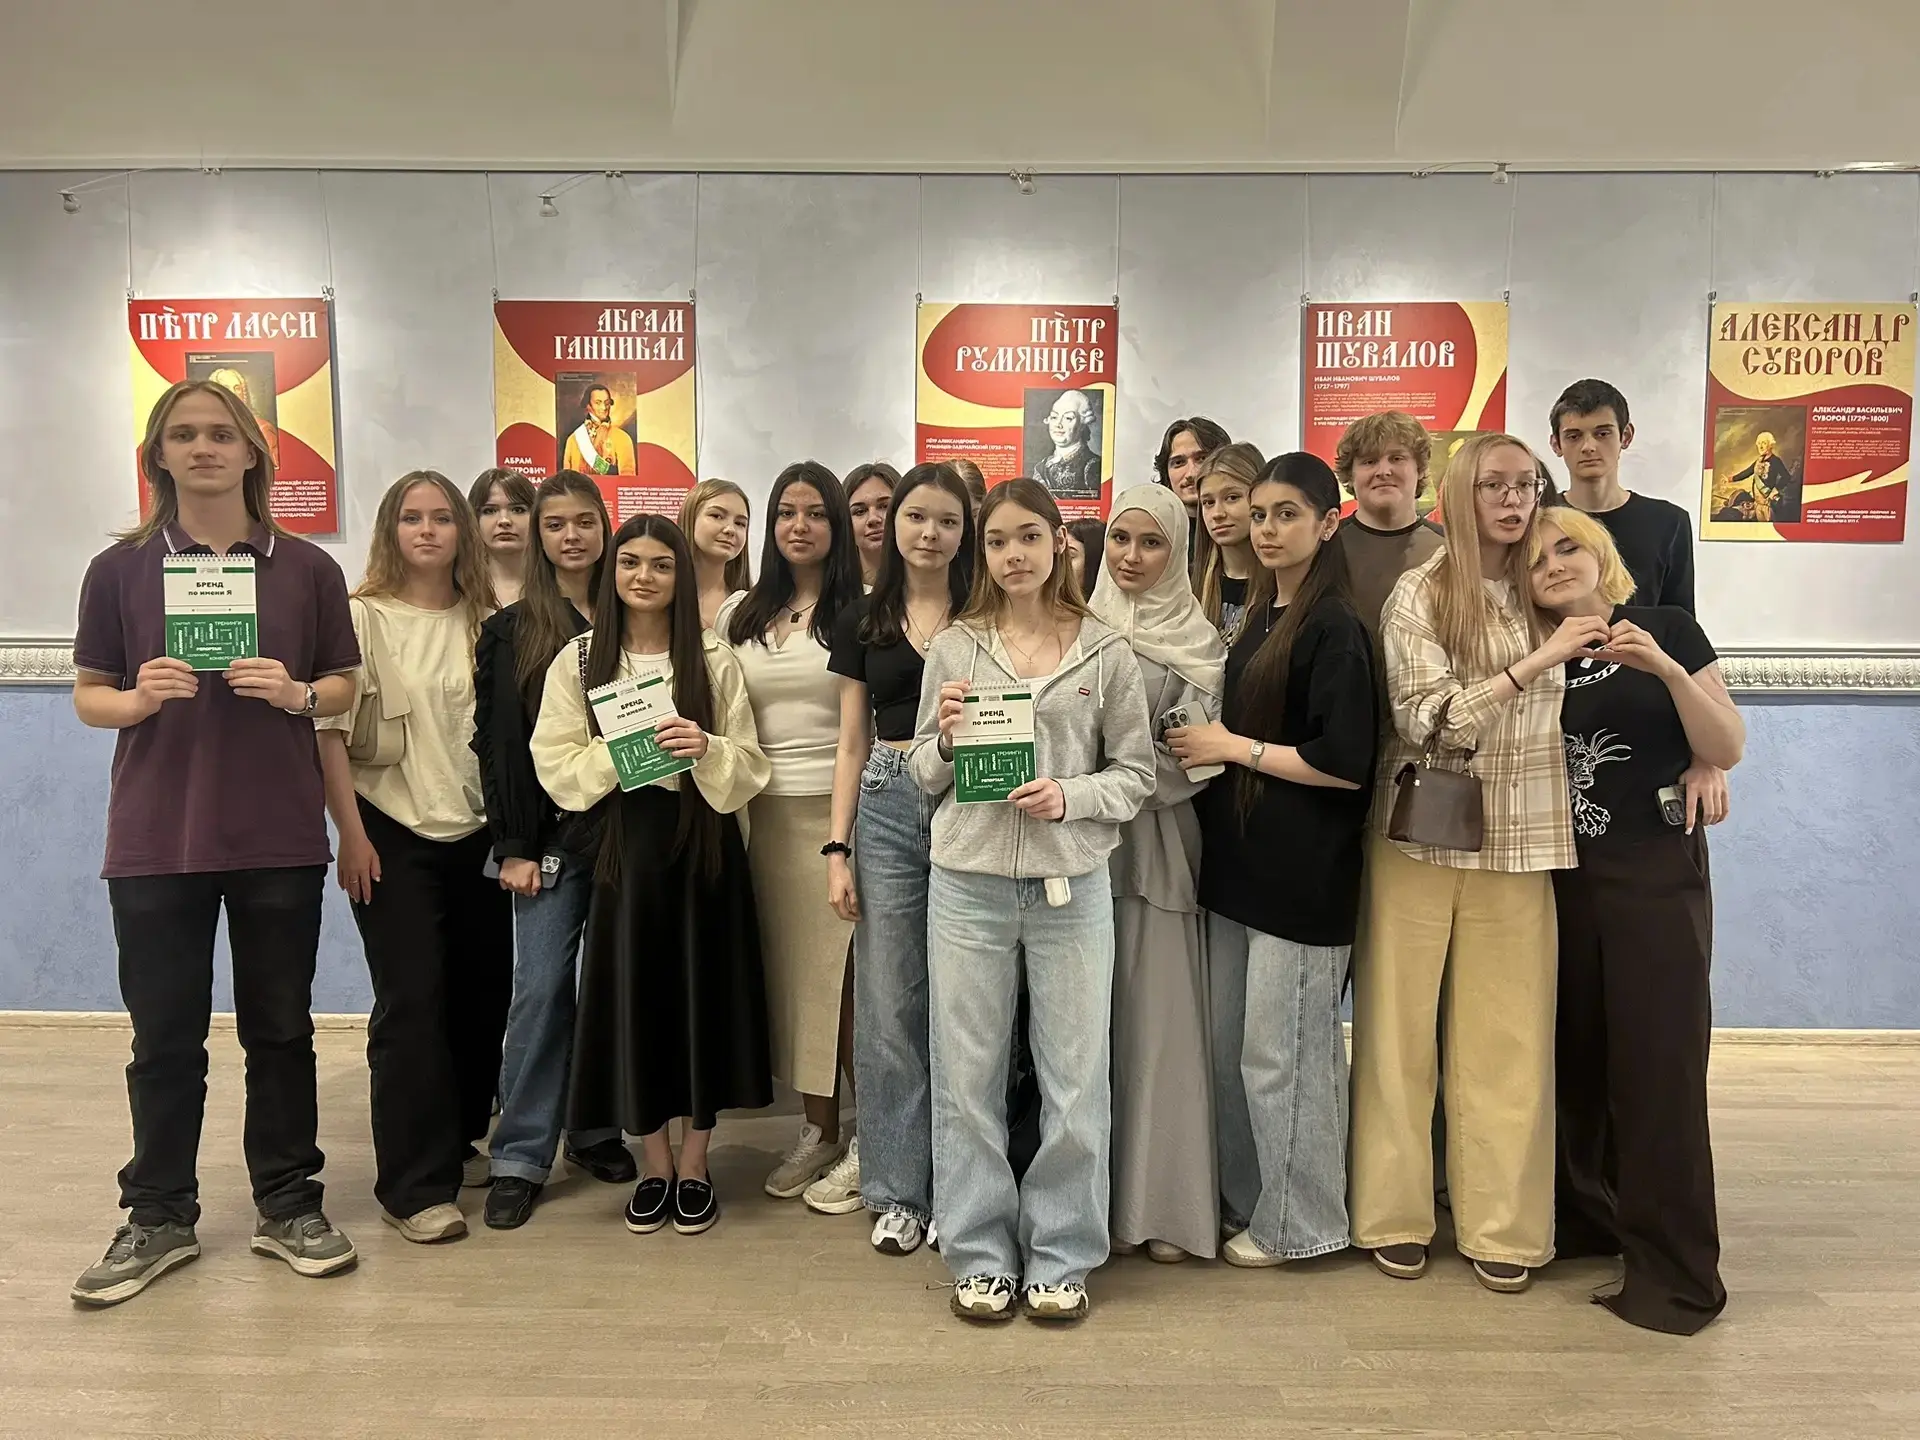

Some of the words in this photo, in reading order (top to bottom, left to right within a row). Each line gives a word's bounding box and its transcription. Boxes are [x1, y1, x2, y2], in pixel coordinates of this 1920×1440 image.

[225, 311, 317, 338] ЛАССИ
[597, 308, 684, 333] АБРАМ
[1316, 310, 1392, 338] ИВАН
[1718, 312, 1910, 350] АЛЕКСАНДР
[554, 336, 684, 360] ГАННИБАЛ
[1315, 340, 1456, 368] ШУВАЛОВ
[1742, 346, 1884, 376] СУВОРОВ
[955, 346, 1104, 382] РУМЯНЦЕВ
[514, 466, 546, 474] ТРОВИЧ
[620, 698, 644, 710] БРЕНД
[626, 707, 646, 716] имени
